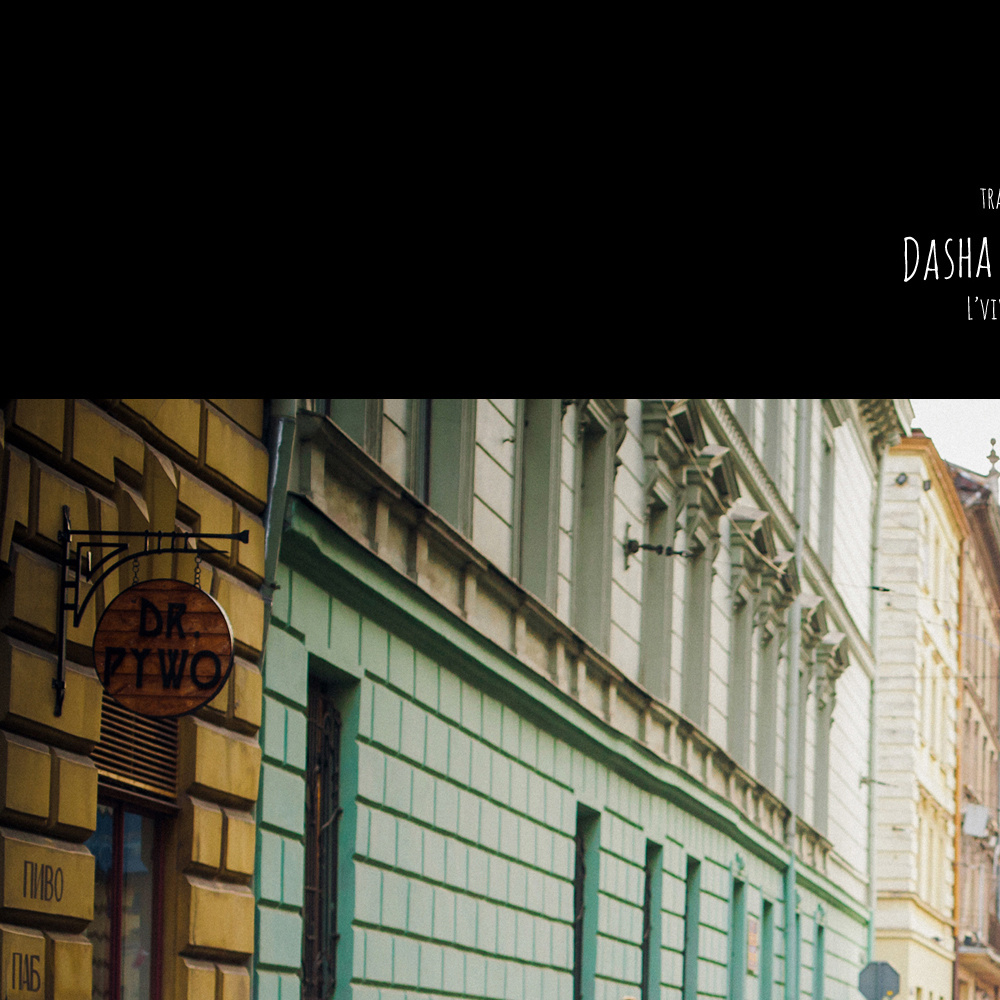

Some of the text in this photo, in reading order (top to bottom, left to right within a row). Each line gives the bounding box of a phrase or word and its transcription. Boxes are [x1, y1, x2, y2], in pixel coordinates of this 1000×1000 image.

[138, 597, 200, 640] DR.
[103, 646, 222, 691] PYWO
[23, 860, 64, 902] ПИВО
[12, 952, 41, 992] ПАБ
